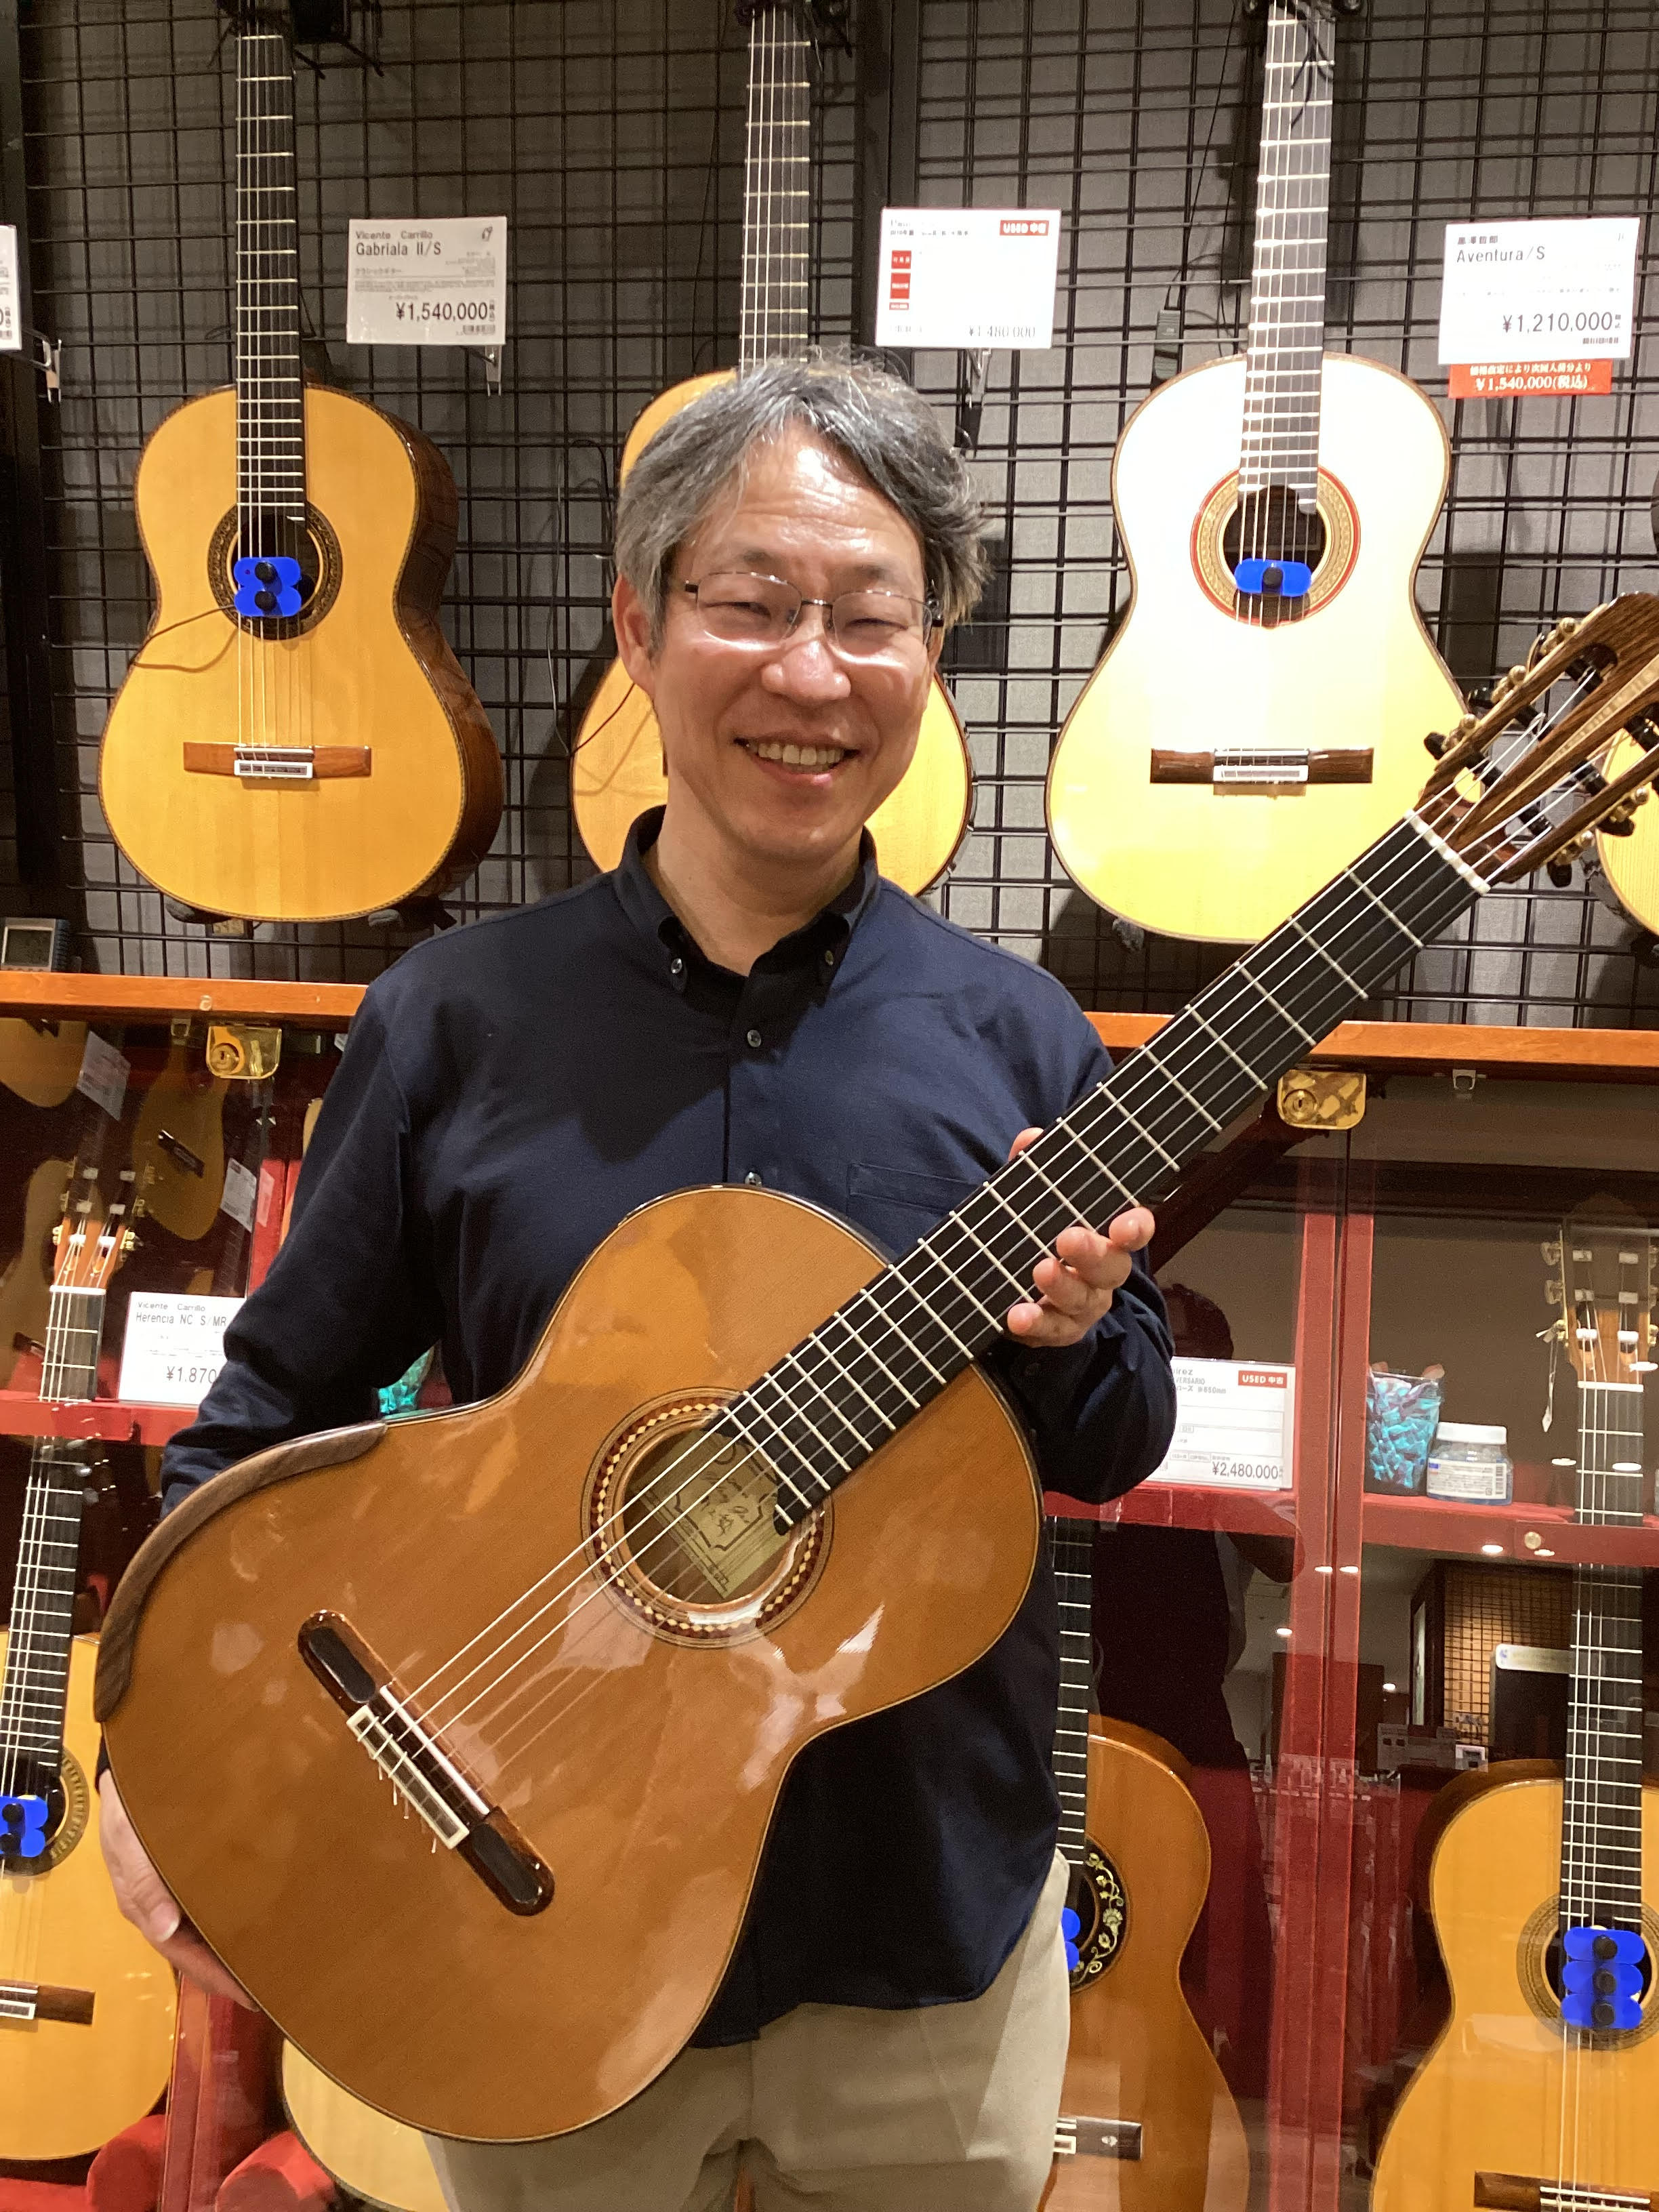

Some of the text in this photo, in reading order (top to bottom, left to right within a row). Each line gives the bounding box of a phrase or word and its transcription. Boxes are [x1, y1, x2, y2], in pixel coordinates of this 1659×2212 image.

[356, 230, 433, 239] Vicente Carrillo
[1456, 246, 1546, 263] Aventura/S
[396, 302, 488, 322] ¥1,540,000
[1502, 312, 1613, 333] ¥1,210,000
[138, 1301, 169, 1309] Vicente
[136, 1312, 174, 1324] Herencia
[180, 1314, 193, 1325] NC
[1242, 1374, 1284, 1385] USED 中古
[1212, 1461, 1279, 1479] ¥2,480,000
